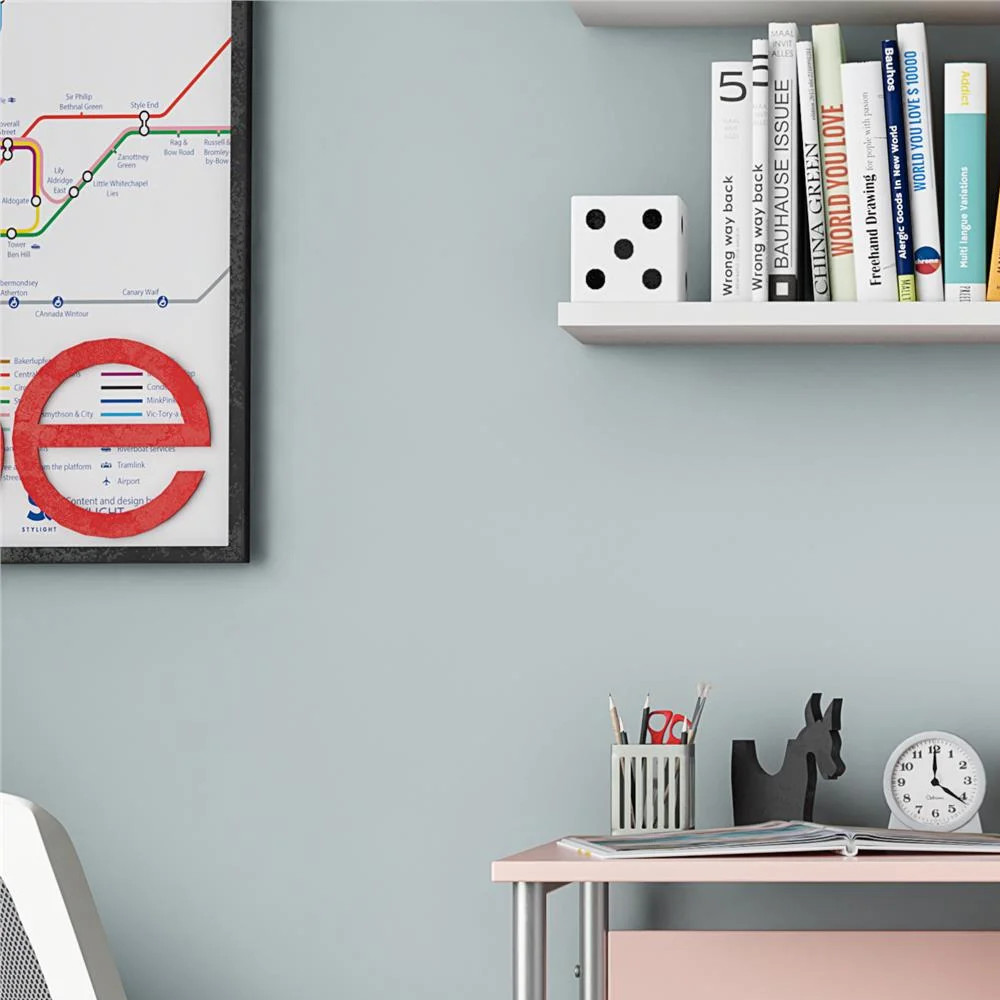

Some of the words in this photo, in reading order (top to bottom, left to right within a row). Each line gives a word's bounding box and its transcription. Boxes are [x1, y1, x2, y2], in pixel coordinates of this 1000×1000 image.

[885, 47, 895, 92] Bauhos
[904, 50, 919, 86] 10000
[75, 93, 92, 102] Philip
[719, 71, 747, 102] 5
[130, 101, 146, 109] Style
[147, 101, 160, 109] End
[774, 79, 789, 151] ISSUEE
[907, 98, 922, 125] LOVE
[821, 104, 846, 147] LOVE
[862, 118, 871, 136] with
[889, 125, 898, 153] World
[909, 126, 923, 151] YOU
[54, 167, 64, 175] Lily
[206, 157, 229, 165] by-Bow
[824, 152, 849, 189] YOU
[892, 155, 901, 177] New
[47, 177, 74, 185] Aldridge
[752, 164, 763, 202] back
[805, 143, 822, 214] GREEN
[911, 153, 926, 192] WORLD
[109, 180, 148, 188] Whitechapel
[722, 175, 733, 212] back
[894, 180, 902, 189] In
[959, 166, 968, 212] Variations
[863, 174, 877, 224] Drawing
[895, 192, 904, 224] Goods
[755, 208, 766, 237] way
[774, 159, 789, 268] BAUHAUSE
[725, 217, 735, 246] way
[828, 194, 854, 257] WORLD
[960, 213, 971, 244] langue
[897, 225, 909, 259] Alergic
[752, 243, 766, 291] Wrong
[811, 222, 829, 294] CHINA
[866, 228, 882, 286] Freehand
[960, 246, 968, 269] Multi
[722, 251, 735, 296] Wrong
[122, 288, 143, 297] Canary
[81, 410, 94, 419] City
[64, 463, 92, 472] platform
[117, 461, 145, 469] Tramlink
[117, 477, 140, 486] Airport
[100, 496, 115, 505] and
[119, 496, 144, 507] design
[912, 750, 922, 759] 11
[928, 745, 941, 754] 12
[949, 750, 953, 758] 1
[901, 762, 914, 771] 10
[959, 761, 967, 769] 2
[897, 778, 905, 786] 9
[963, 776, 972, 785] 3
[903, 794, 911, 803] 8
[960, 792, 967, 801] 4
[915, 805, 923, 814] 7
[932, 809, 939, 818] 6
[948, 805, 956, 813] 5
